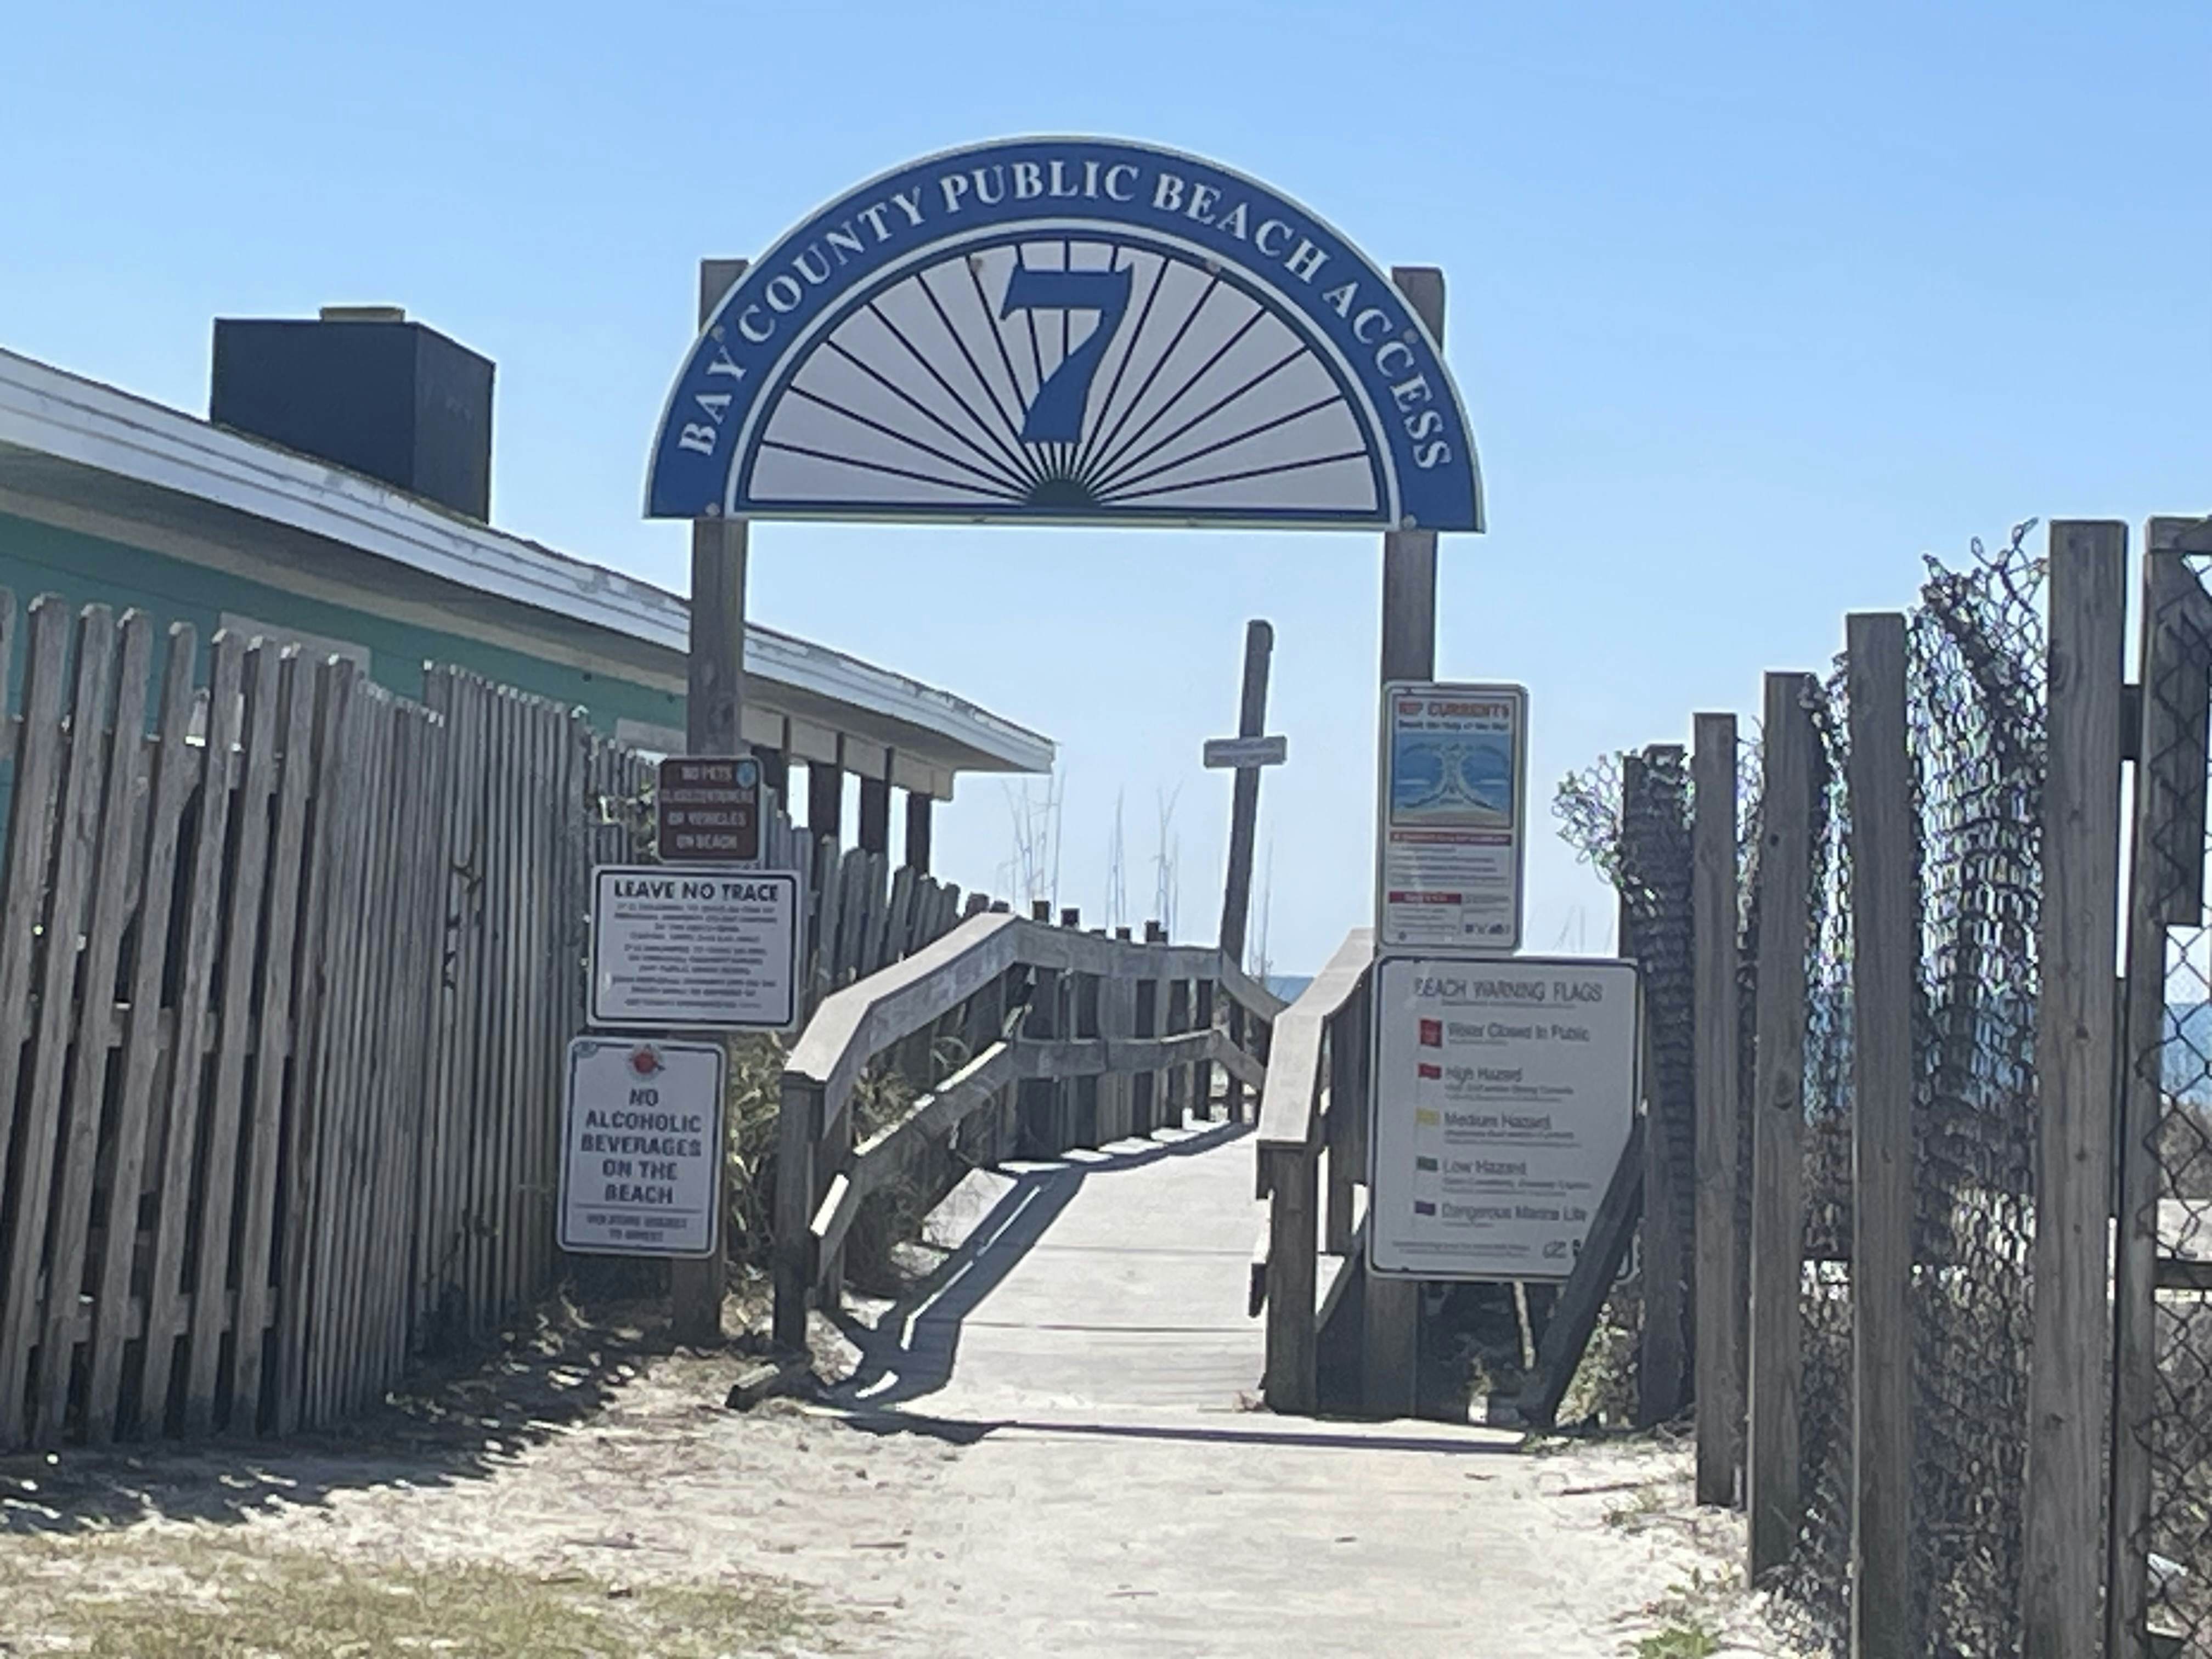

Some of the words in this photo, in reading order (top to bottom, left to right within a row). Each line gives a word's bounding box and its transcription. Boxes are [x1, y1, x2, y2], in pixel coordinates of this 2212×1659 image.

[678, 345, 747, 456] BAY
[737, 185, 927, 343] COUNTY
[939, 160, 1139, 213] PUBLIC
[1152, 172, 1331, 284] BEACH
[1322, 281, 1452, 469] ACCESS
[1000, 261, 1133, 445] 7
[614, 879, 675, 900] LEAVE
[681, 881, 715, 899] NO
[721, 884, 778, 902] TRACE
[1414, 977, 1467, 997] BEACH
[1473, 979, 1545, 1002] WARNING
[1553, 980, 1603, 1002] FLAGS
[629, 1088, 659, 1107] NO
[585, 1110, 702, 1133] ALCOHOLIC
[580, 1134, 702, 1157] BEVERAGES
[602, 1158, 633, 1178] ON
[638, 1161, 679, 1181] THE
[605, 1183, 674, 1204] BEACH
